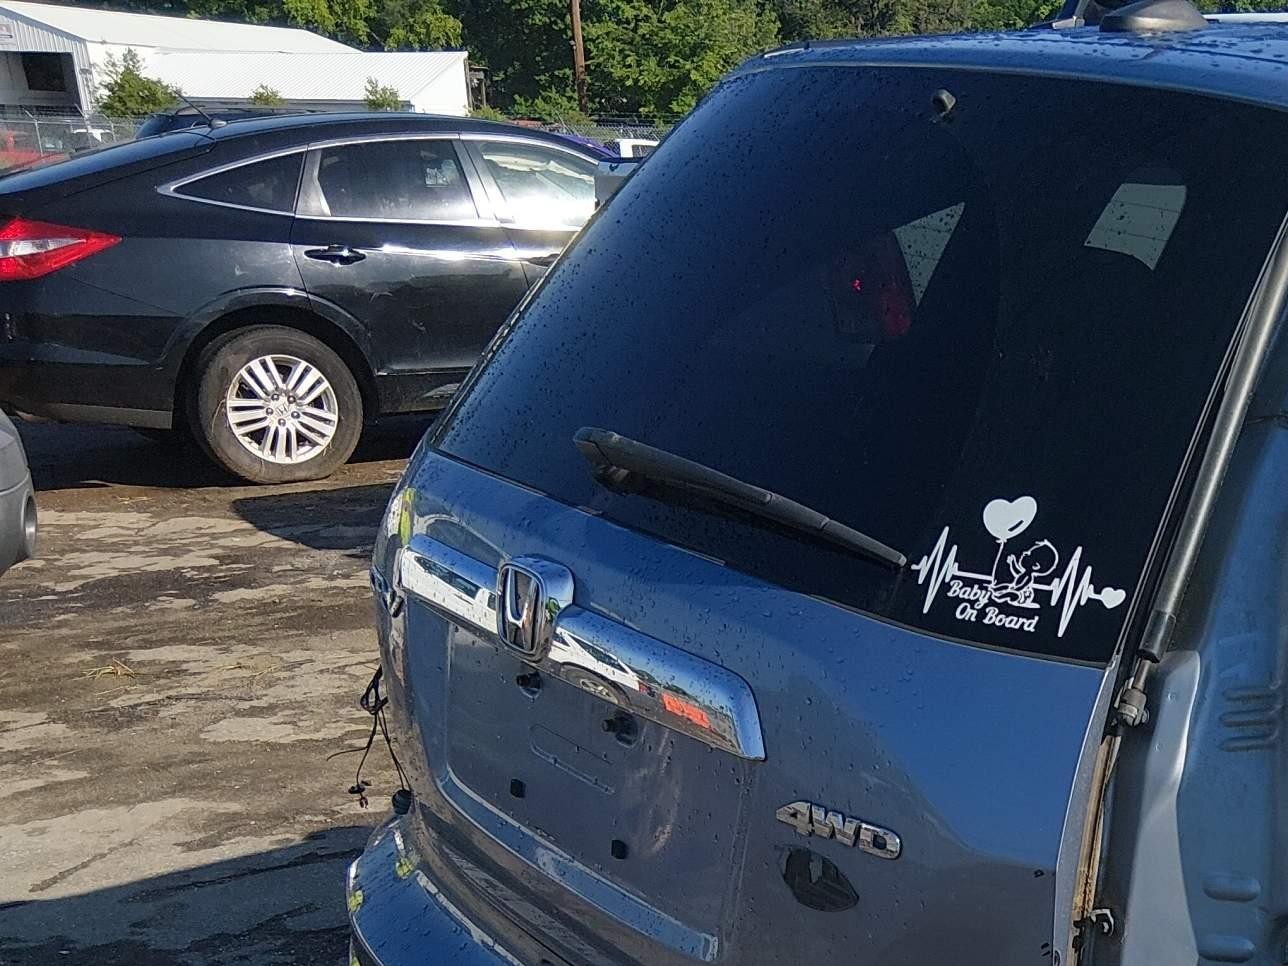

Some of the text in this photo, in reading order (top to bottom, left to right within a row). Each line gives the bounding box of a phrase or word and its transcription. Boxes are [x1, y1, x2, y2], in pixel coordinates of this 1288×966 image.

[947, 580, 991, 609] Baby
[955, 602, 1039, 632] On Board
[775, 800, 902, 860] 4WD
